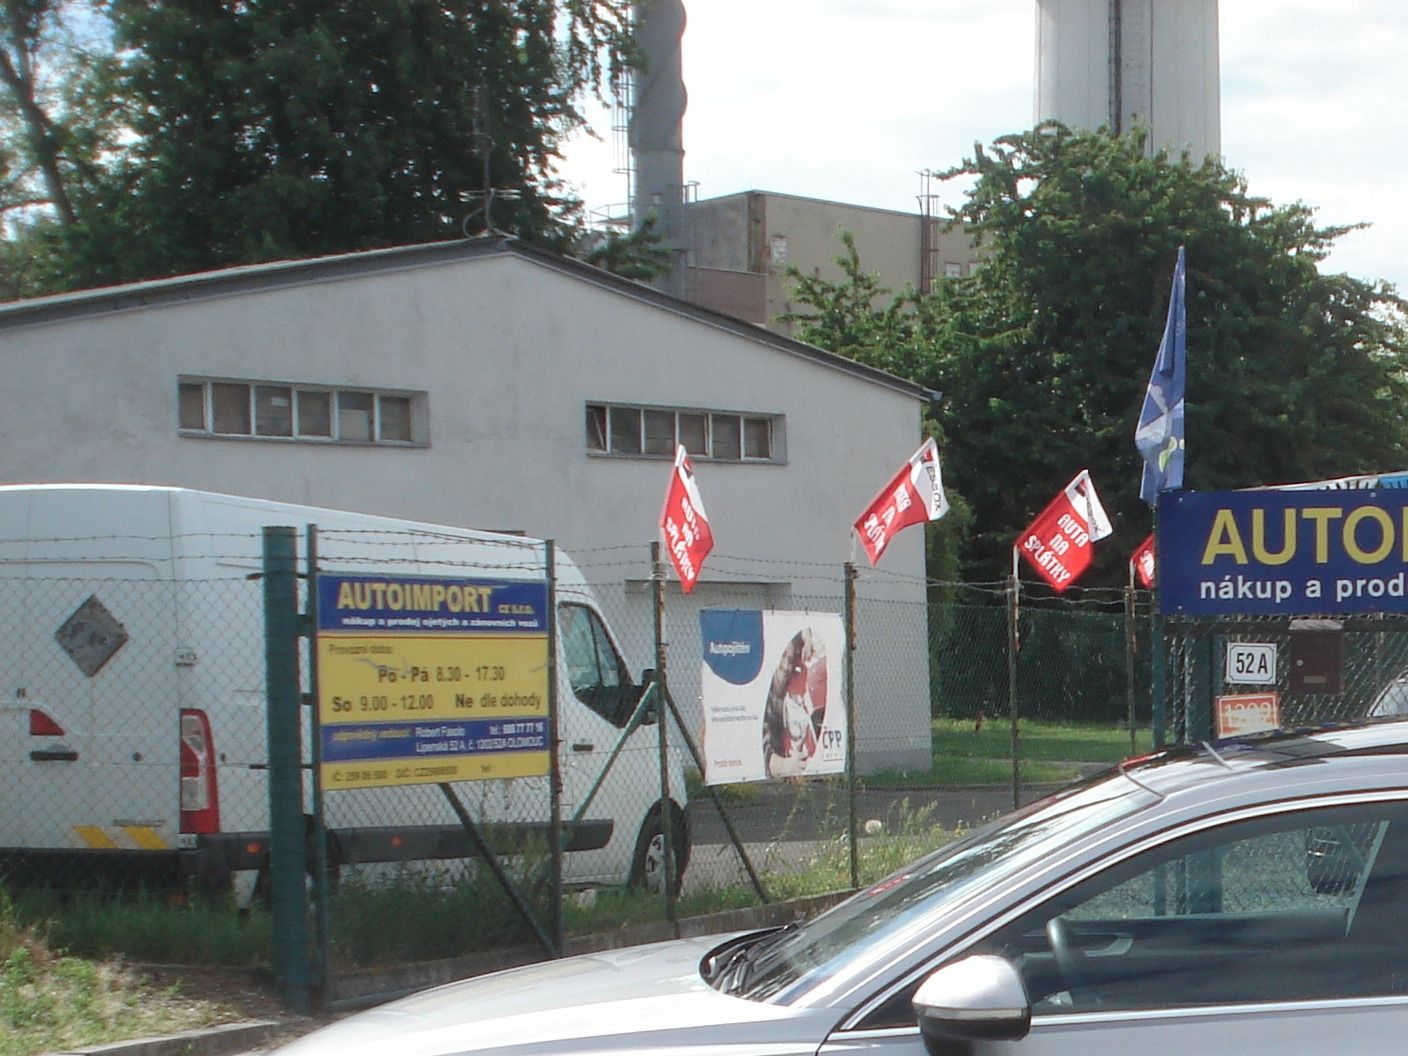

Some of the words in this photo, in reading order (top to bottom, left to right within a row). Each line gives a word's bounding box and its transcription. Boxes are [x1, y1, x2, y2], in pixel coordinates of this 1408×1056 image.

[1057, 513, 1089, 548] AUTA
[1049, 533, 1070, 556] NA
[1023, 534, 1071, 584] SPLÁTKY
[336, 581, 494, 614] AUTOIMPORT
[1200, 574, 1293, 603] nákup
[1305, 579, 1321, 599] a
[387, 617, 421, 628] prodej
[378, 665, 397, 683] Po
[410, 664, 429, 683] Pá
[436, 665, 462, 682] 8.30
[476, 665, 505, 681] 17.30
[1235, 652, 1255, 674] 52
[1257, 652, 1268, 674] A
[332, 696, 352, 712] So
[360, 696, 388, 711] 9.00
[401, 695, 434, 710] 12.00
[455, 694, 473, 709] Ne
[480, 693, 497, 708] dle
[501, 692, 542, 711] dohody
[822, 725, 842, 749] ČPP
